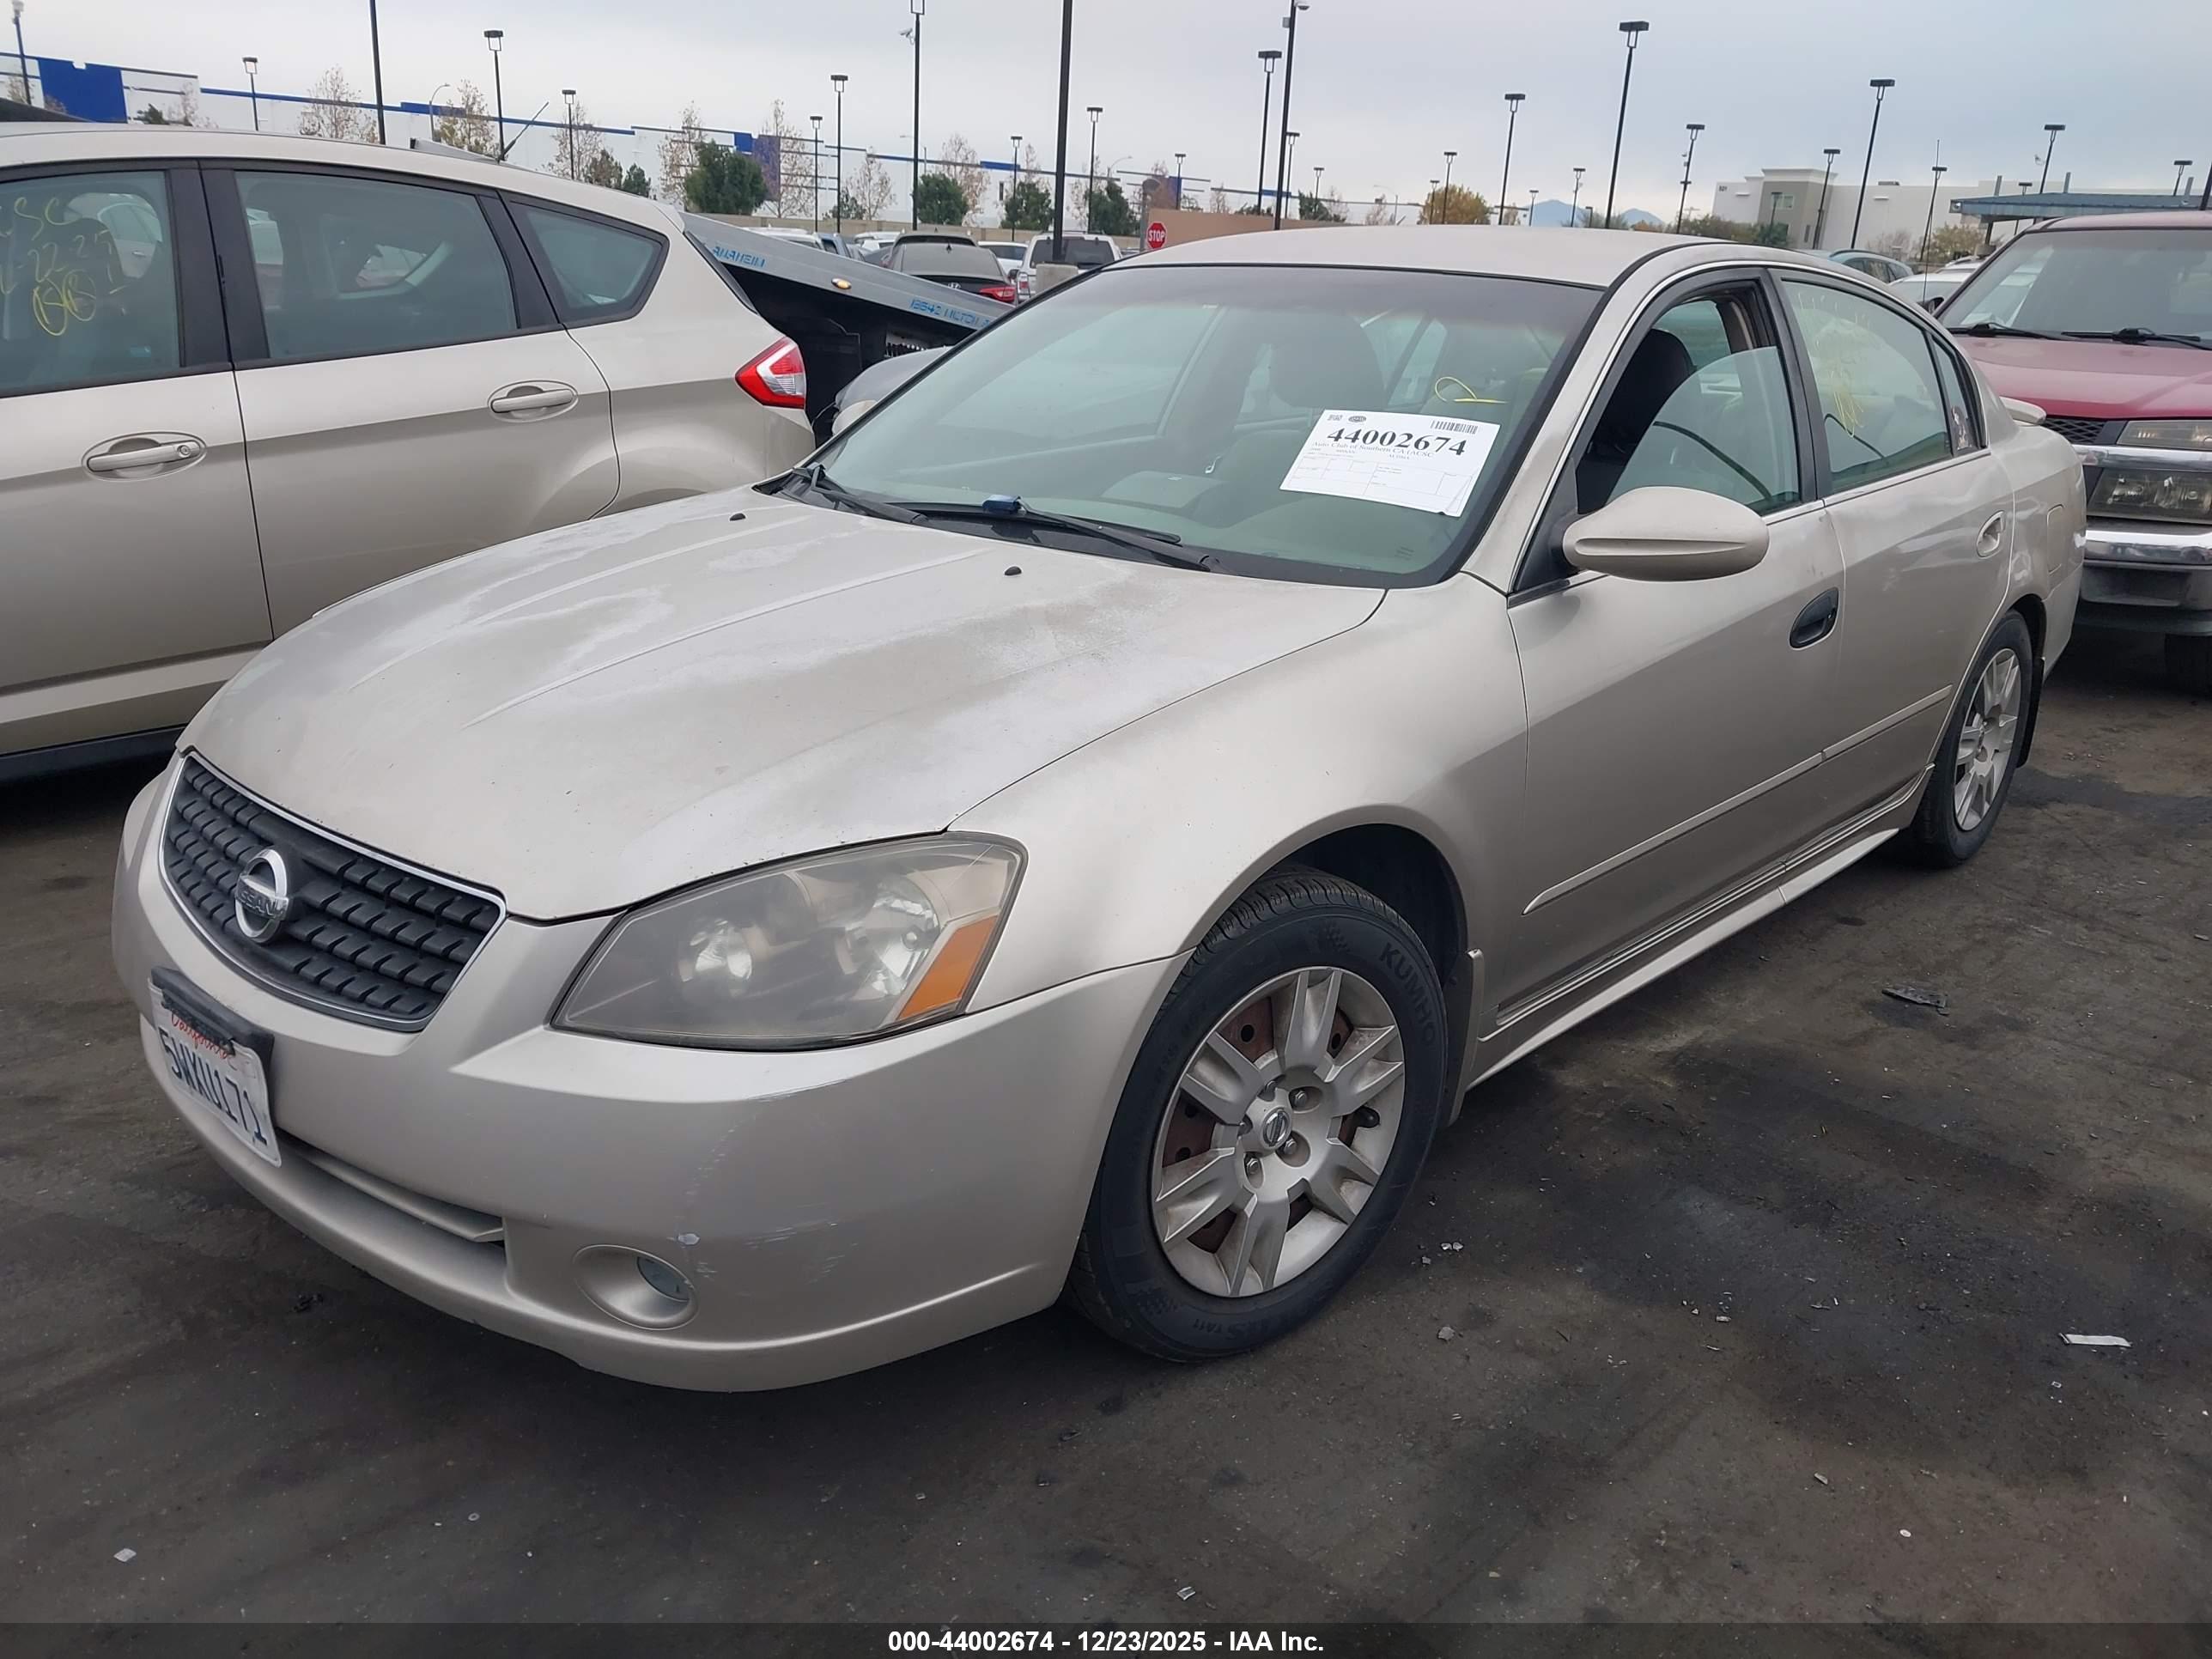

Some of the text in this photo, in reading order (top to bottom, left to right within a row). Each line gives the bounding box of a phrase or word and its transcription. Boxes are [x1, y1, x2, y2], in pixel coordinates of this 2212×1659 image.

[1148, 229, 1165, 241] STOP
[1327, 427, 1467, 456] 44002674
[1379, 942, 1436, 1042] KUMHO
